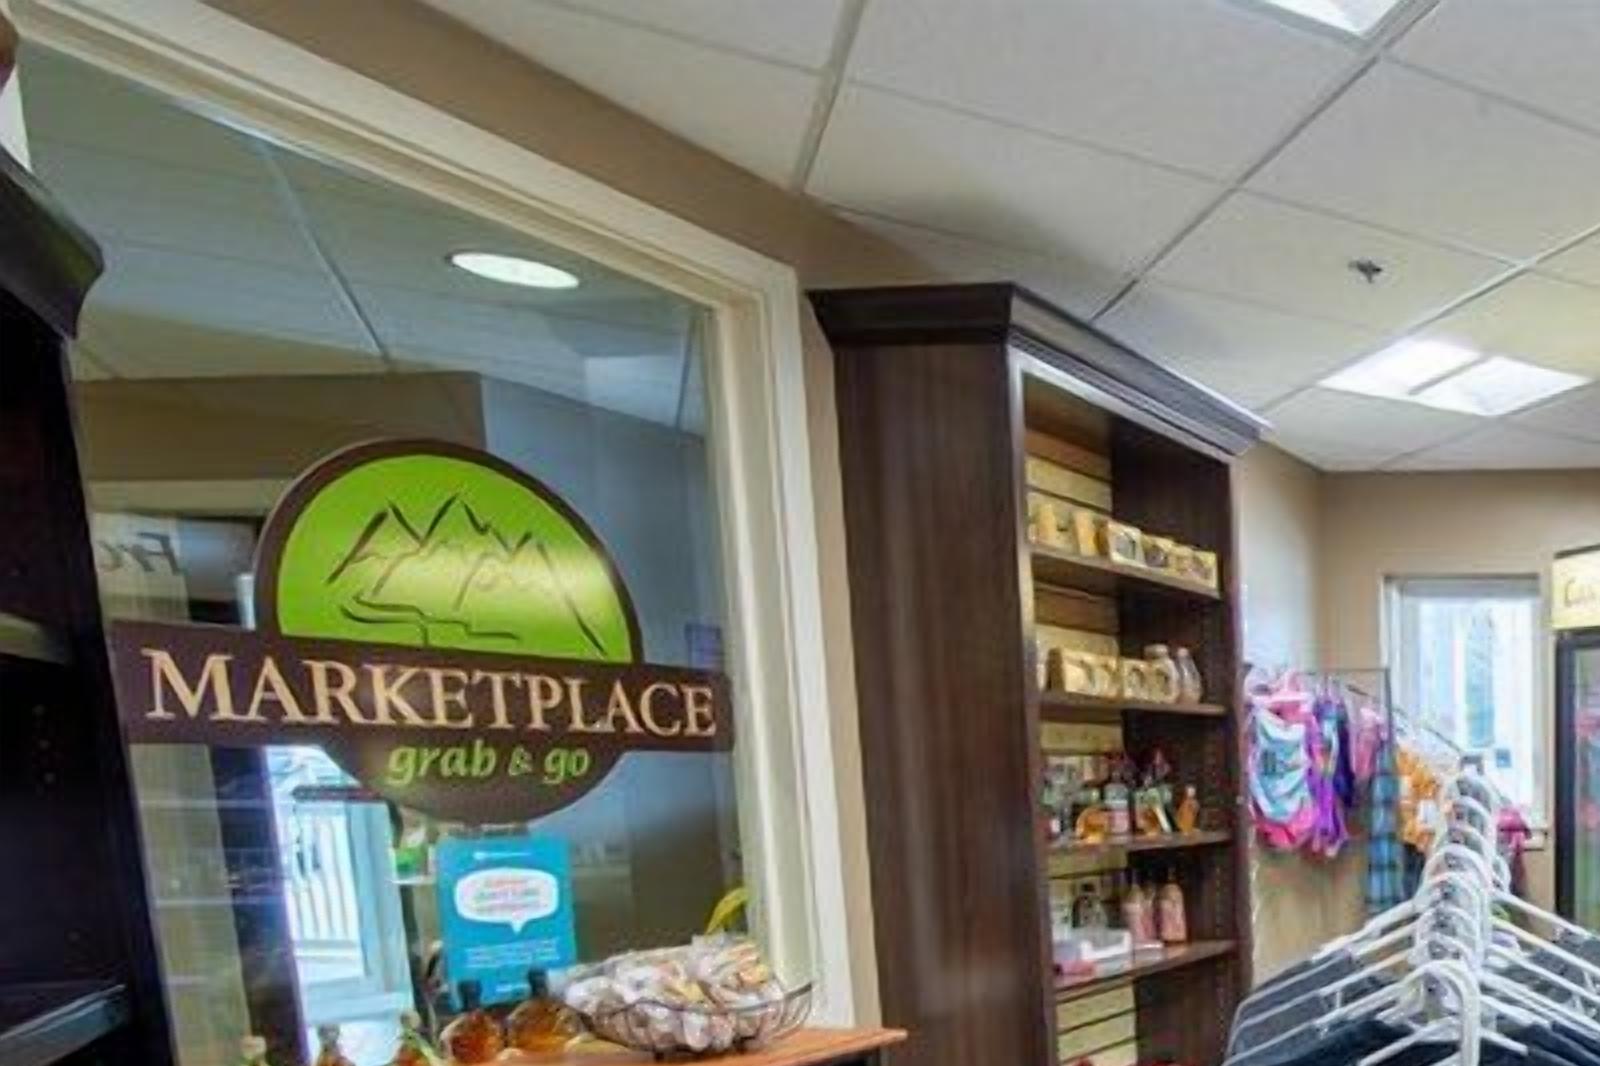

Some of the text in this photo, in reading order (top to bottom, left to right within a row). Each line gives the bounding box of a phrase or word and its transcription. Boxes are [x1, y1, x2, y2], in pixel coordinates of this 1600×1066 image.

[141, 649, 717, 738] MARKETPLACE
[387, 739, 590, 788] grab & go
